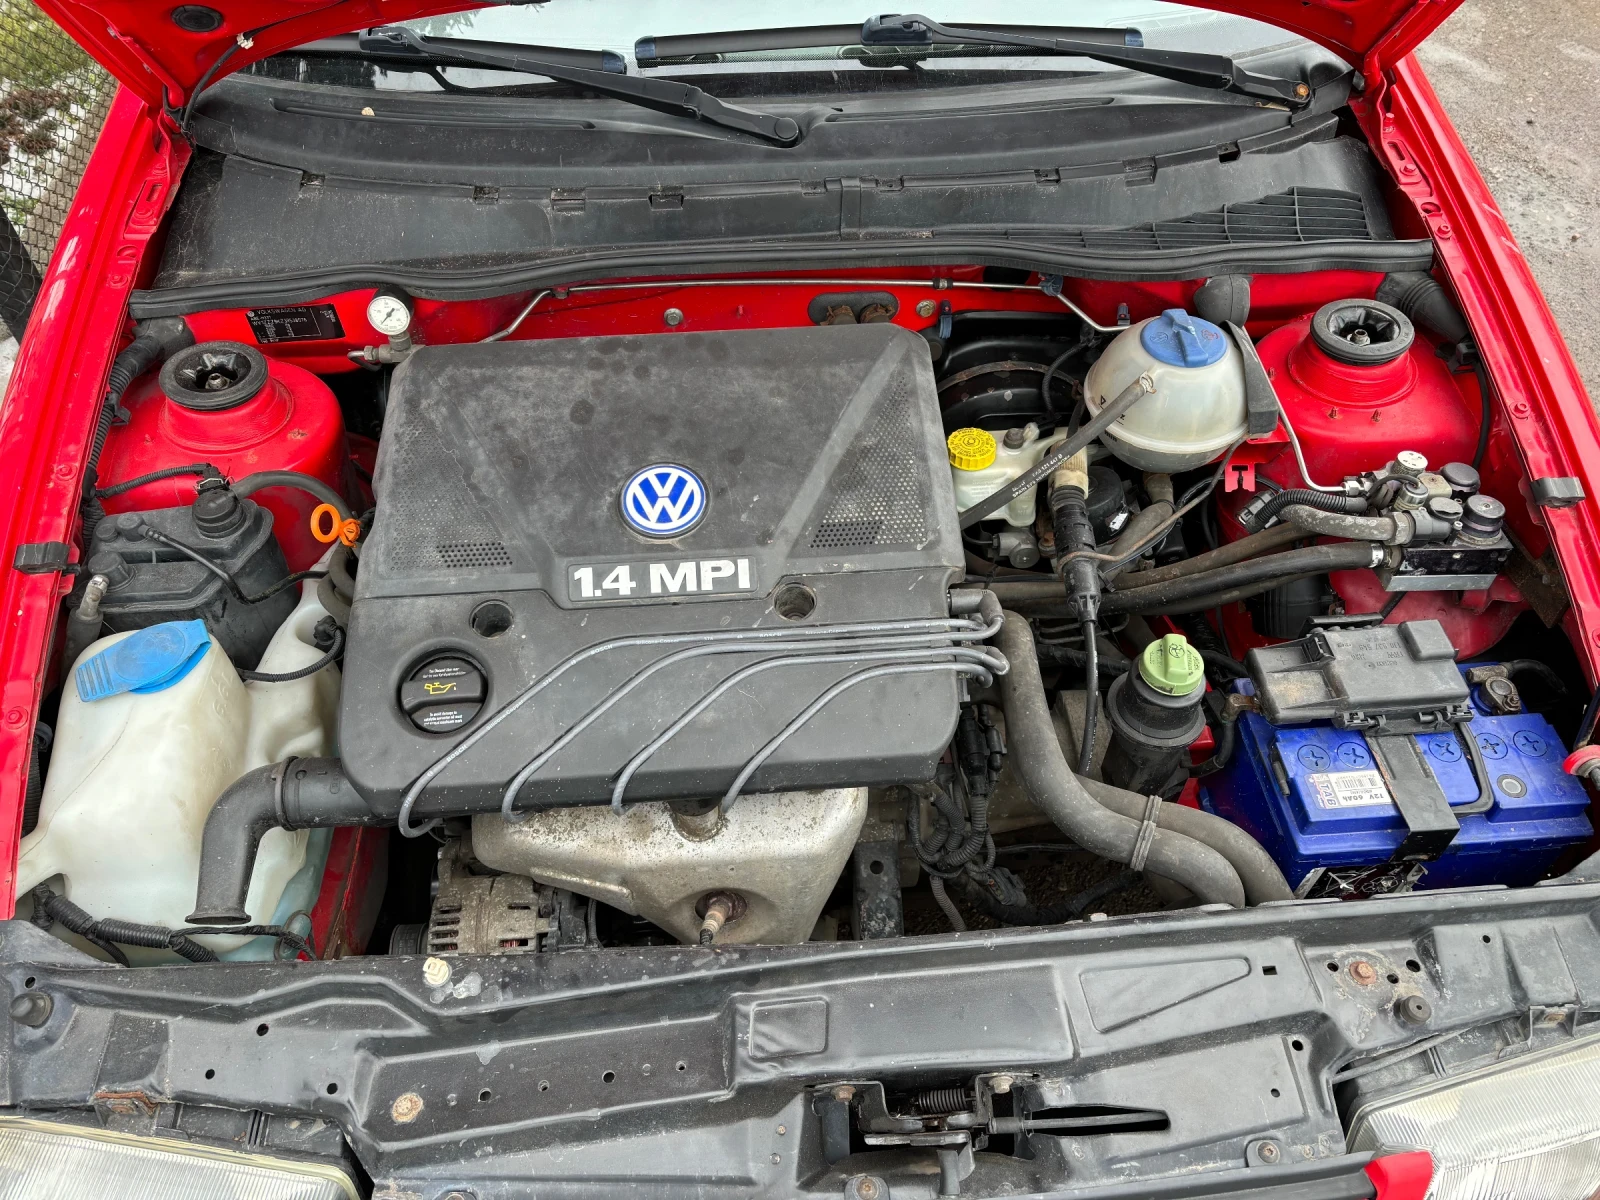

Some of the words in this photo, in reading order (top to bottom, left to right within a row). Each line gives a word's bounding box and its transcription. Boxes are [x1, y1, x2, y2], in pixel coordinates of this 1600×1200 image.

[573, 565, 637, 598] 1.4
[649, 558, 751, 594] MPI
[590, 644, 613, 655] BOSCH
[446, 744, 468, 763] BOSCH
[1320, 783, 1337, 806] TAB
[1342, 794, 1364, 802] 60Ah
